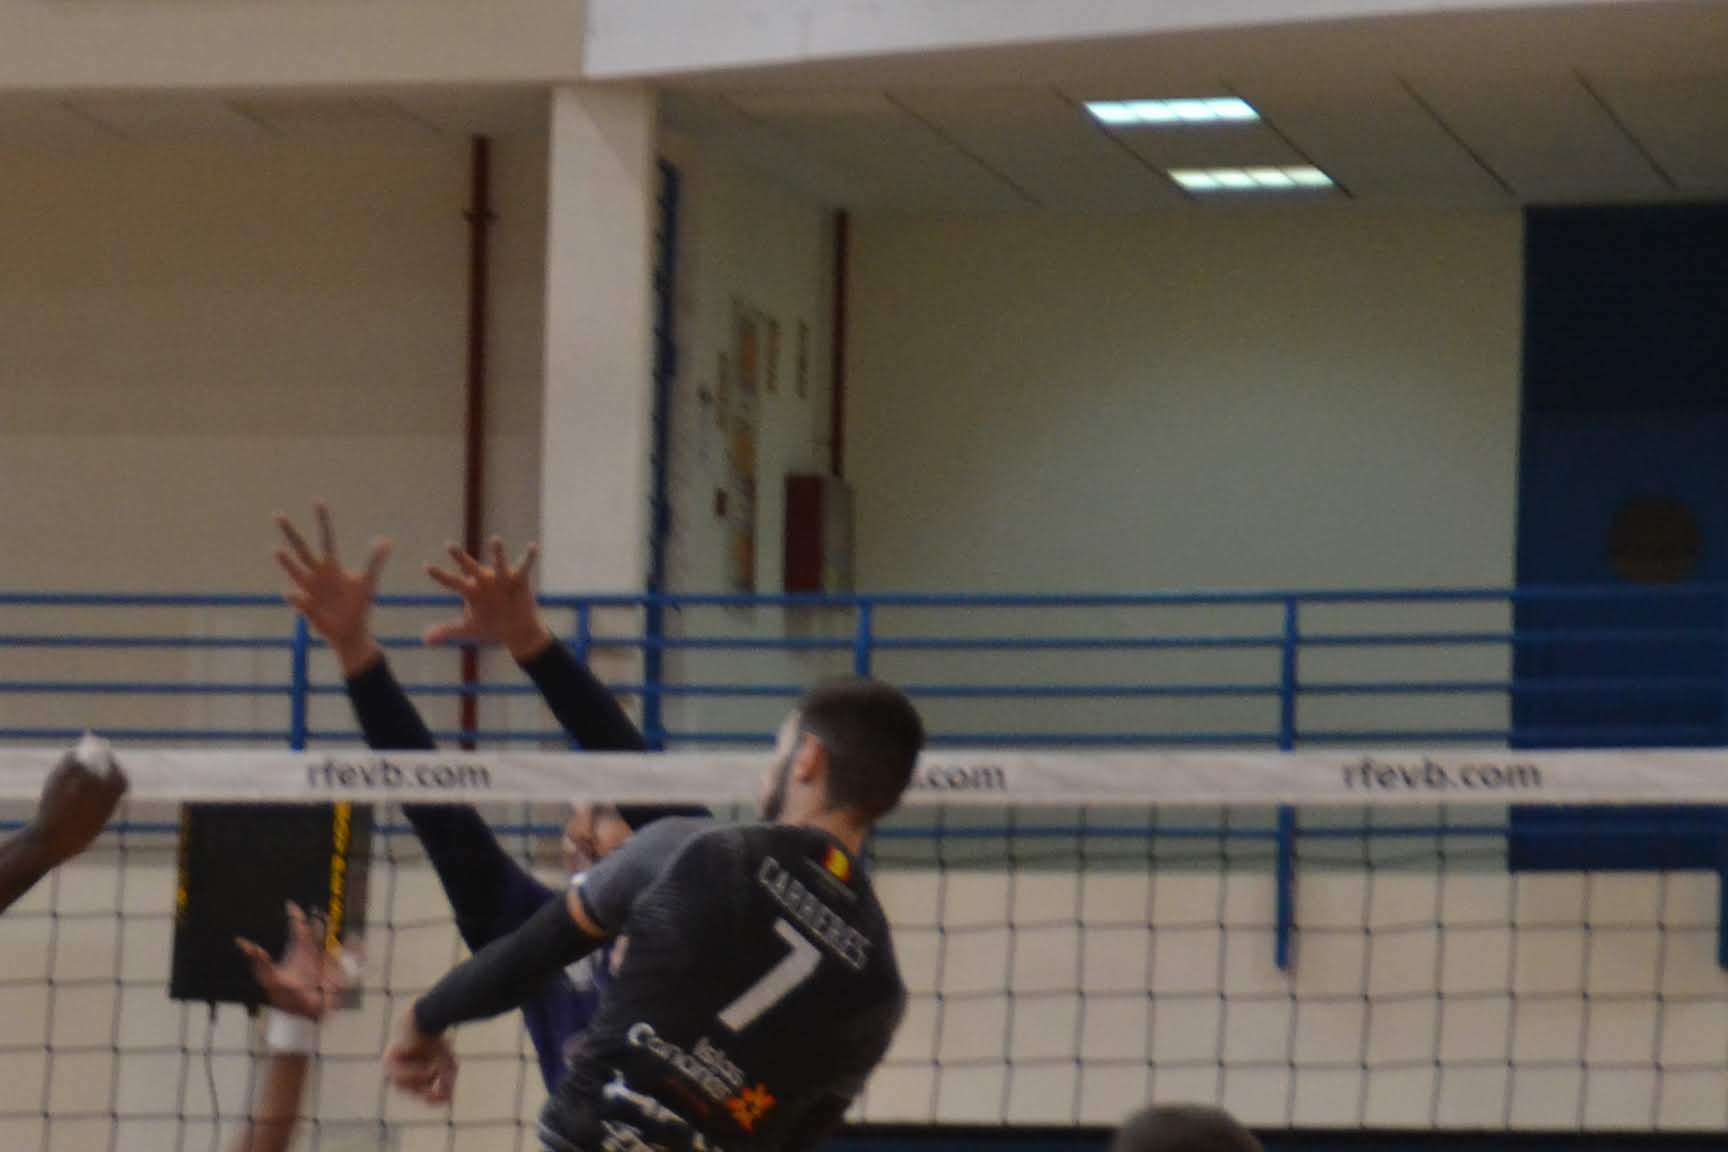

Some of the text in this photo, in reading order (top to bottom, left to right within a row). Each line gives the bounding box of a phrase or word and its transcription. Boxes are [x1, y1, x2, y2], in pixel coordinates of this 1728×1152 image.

[306, 752, 492, 789] rfevb.com
[1340, 758, 1544, 792] rfevb.com
[717, 917, 821, 1033] 7
